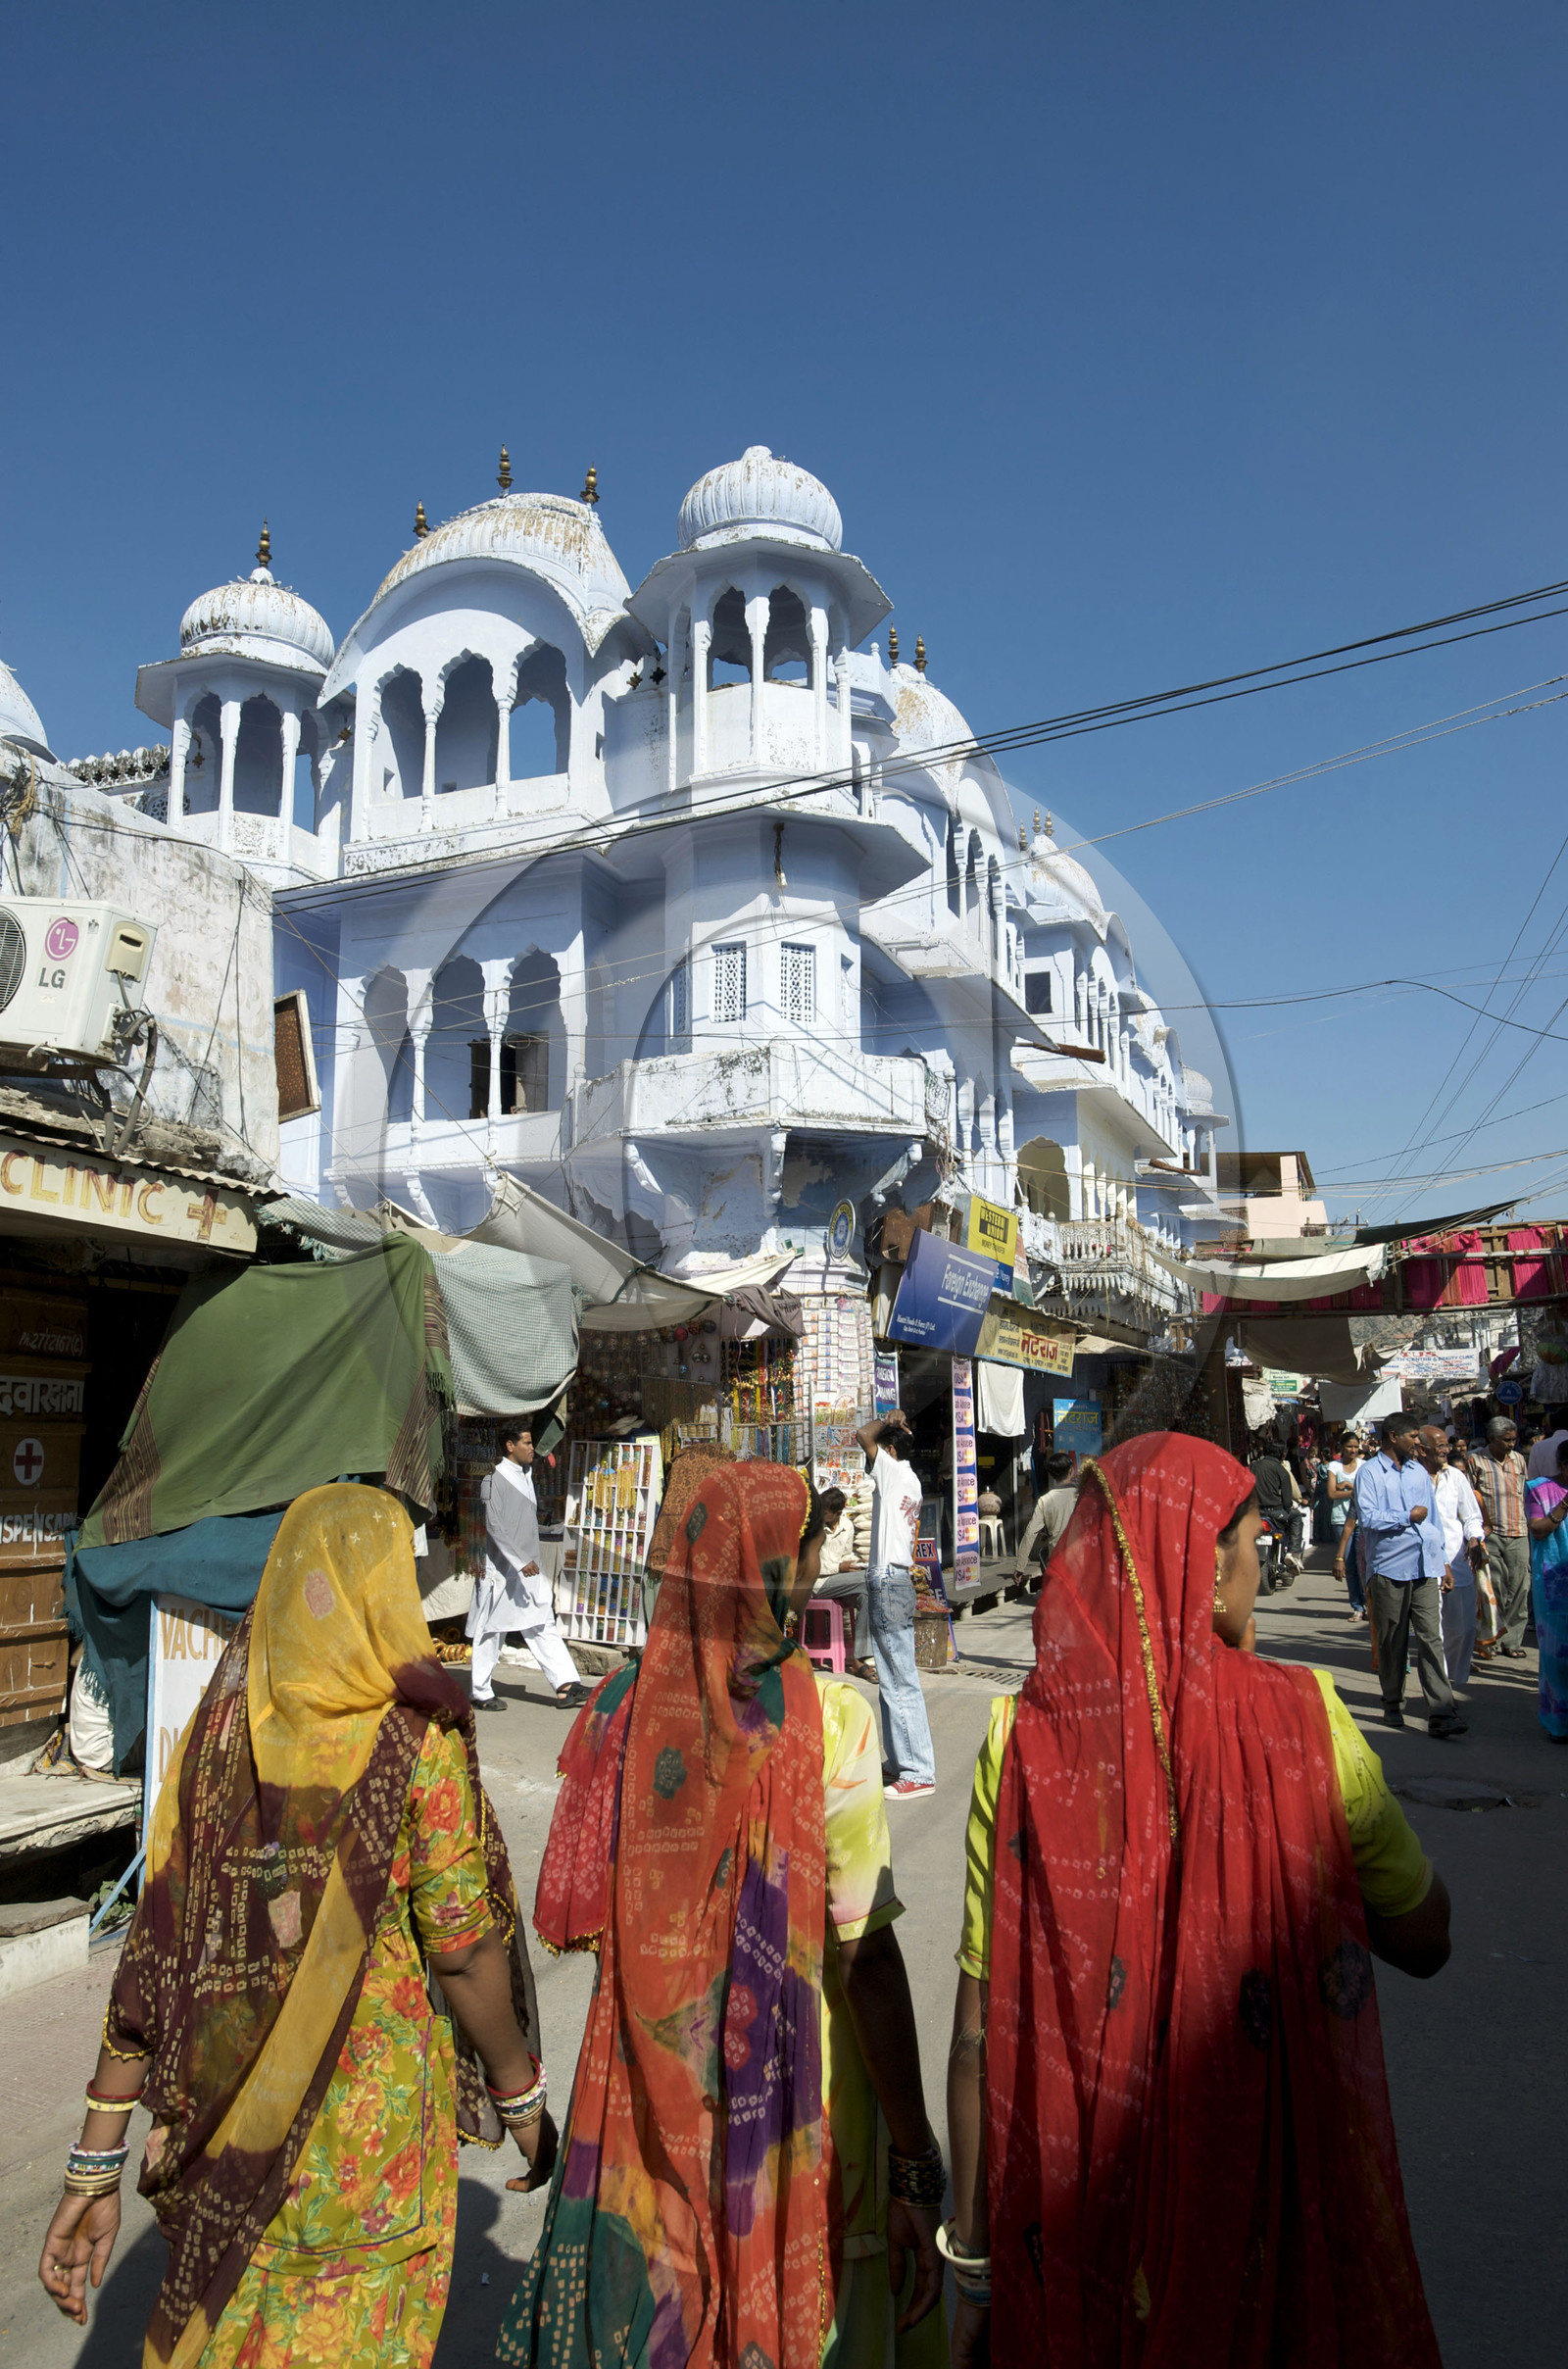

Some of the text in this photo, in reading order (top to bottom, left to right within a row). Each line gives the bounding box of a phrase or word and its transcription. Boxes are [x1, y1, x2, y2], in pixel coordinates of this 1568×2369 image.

[38, 966, 67, 989] LG
[0, 1149, 166, 1225] CLINIC
[981, 1209, 1005, 1228] WESTERN
[987, 1222, 1004, 1241] UNION
[941, 1262, 990, 1309] Foreign Exchange
[1021, 1331, 1059, 1360] नटराज
[1057, 1409, 1100, 1425] नटराज
